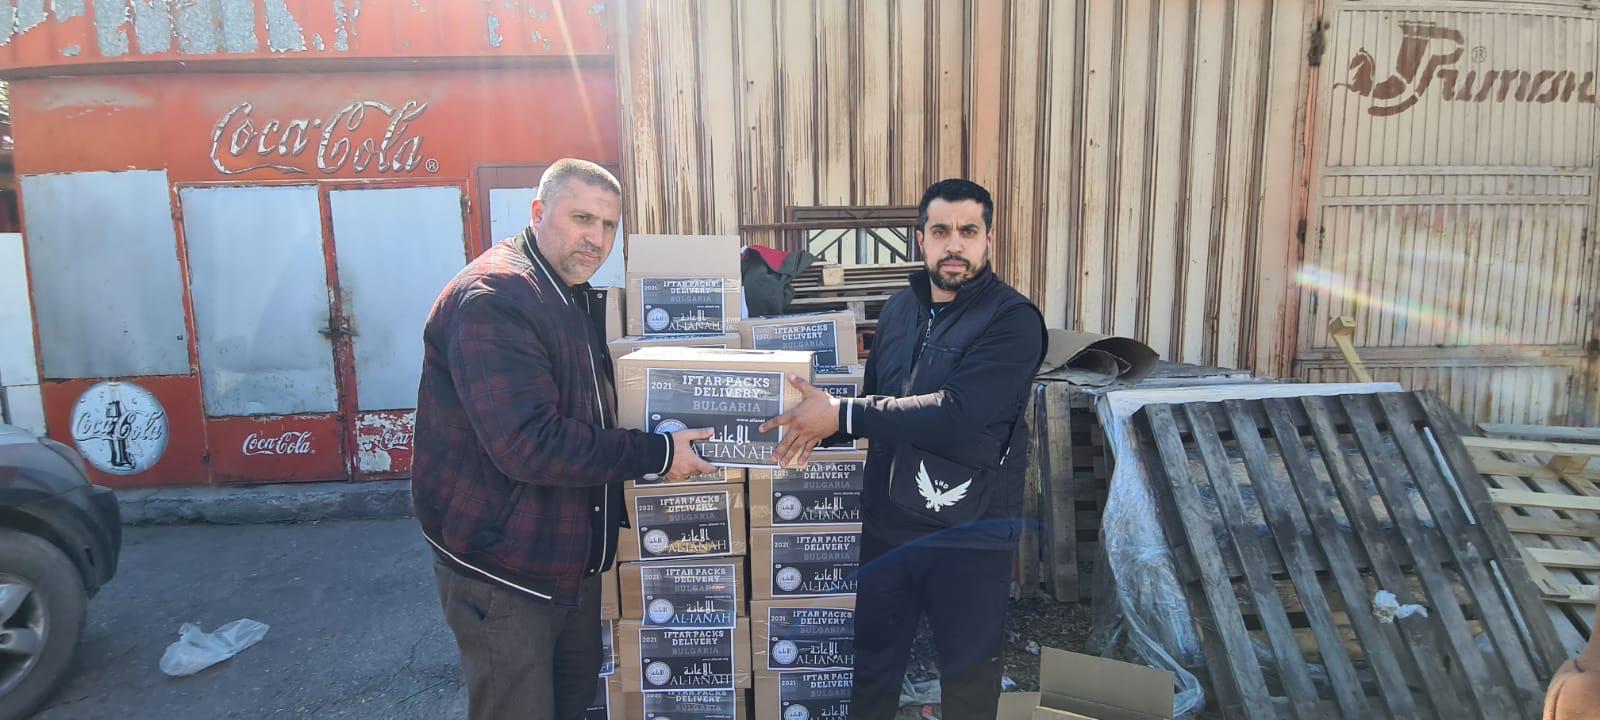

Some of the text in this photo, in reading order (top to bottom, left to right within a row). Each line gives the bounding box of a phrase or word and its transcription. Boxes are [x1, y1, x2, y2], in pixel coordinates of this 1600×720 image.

[210, 100, 428, 174] Coca-Cola
[775, 324, 828, 335] IFTAR PACKS
[782, 331, 823, 341] DELIVERY
[650, 381, 672, 390] 2021
[682, 375, 771, 388] IFTAR PACKS
[693, 386, 761, 399] DELIVERY
[693, 400, 761, 413] BULGARIA
[243, 431, 312, 456] Coca-Cola
[690, 443, 774, 461] AL-IANAH
[825, 464, 857, 472] PACKS
[803, 471, 850, 479] DELIVERY
[660, 495, 720, 506] IFTAR PACKS
[800, 508, 860, 521] AL-IANAH
[796, 535, 856, 544] IFTAR PACKS
[804, 543, 850, 551] DELIVERY
[666, 567, 727, 576] IFTAR PACKS
[674, 575, 720, 583] DELIVERY
[800, 580, 858, 592] AL-IANAH
[671, 612, 731, 624] AL-IANAH
[792, 610, 853, 619] IFTAR PACKS
[800, 617, 846, 625] DELIVERY
[663, 630, 724, 639] IFTAR PACKS
[671, 638, 718, 646] DELIVERY
[670, 674, 729, 686] AL-IANAH
[802, 674, 830, 682] IFTAR
[675, 695, 721, 703] DELIVERY
